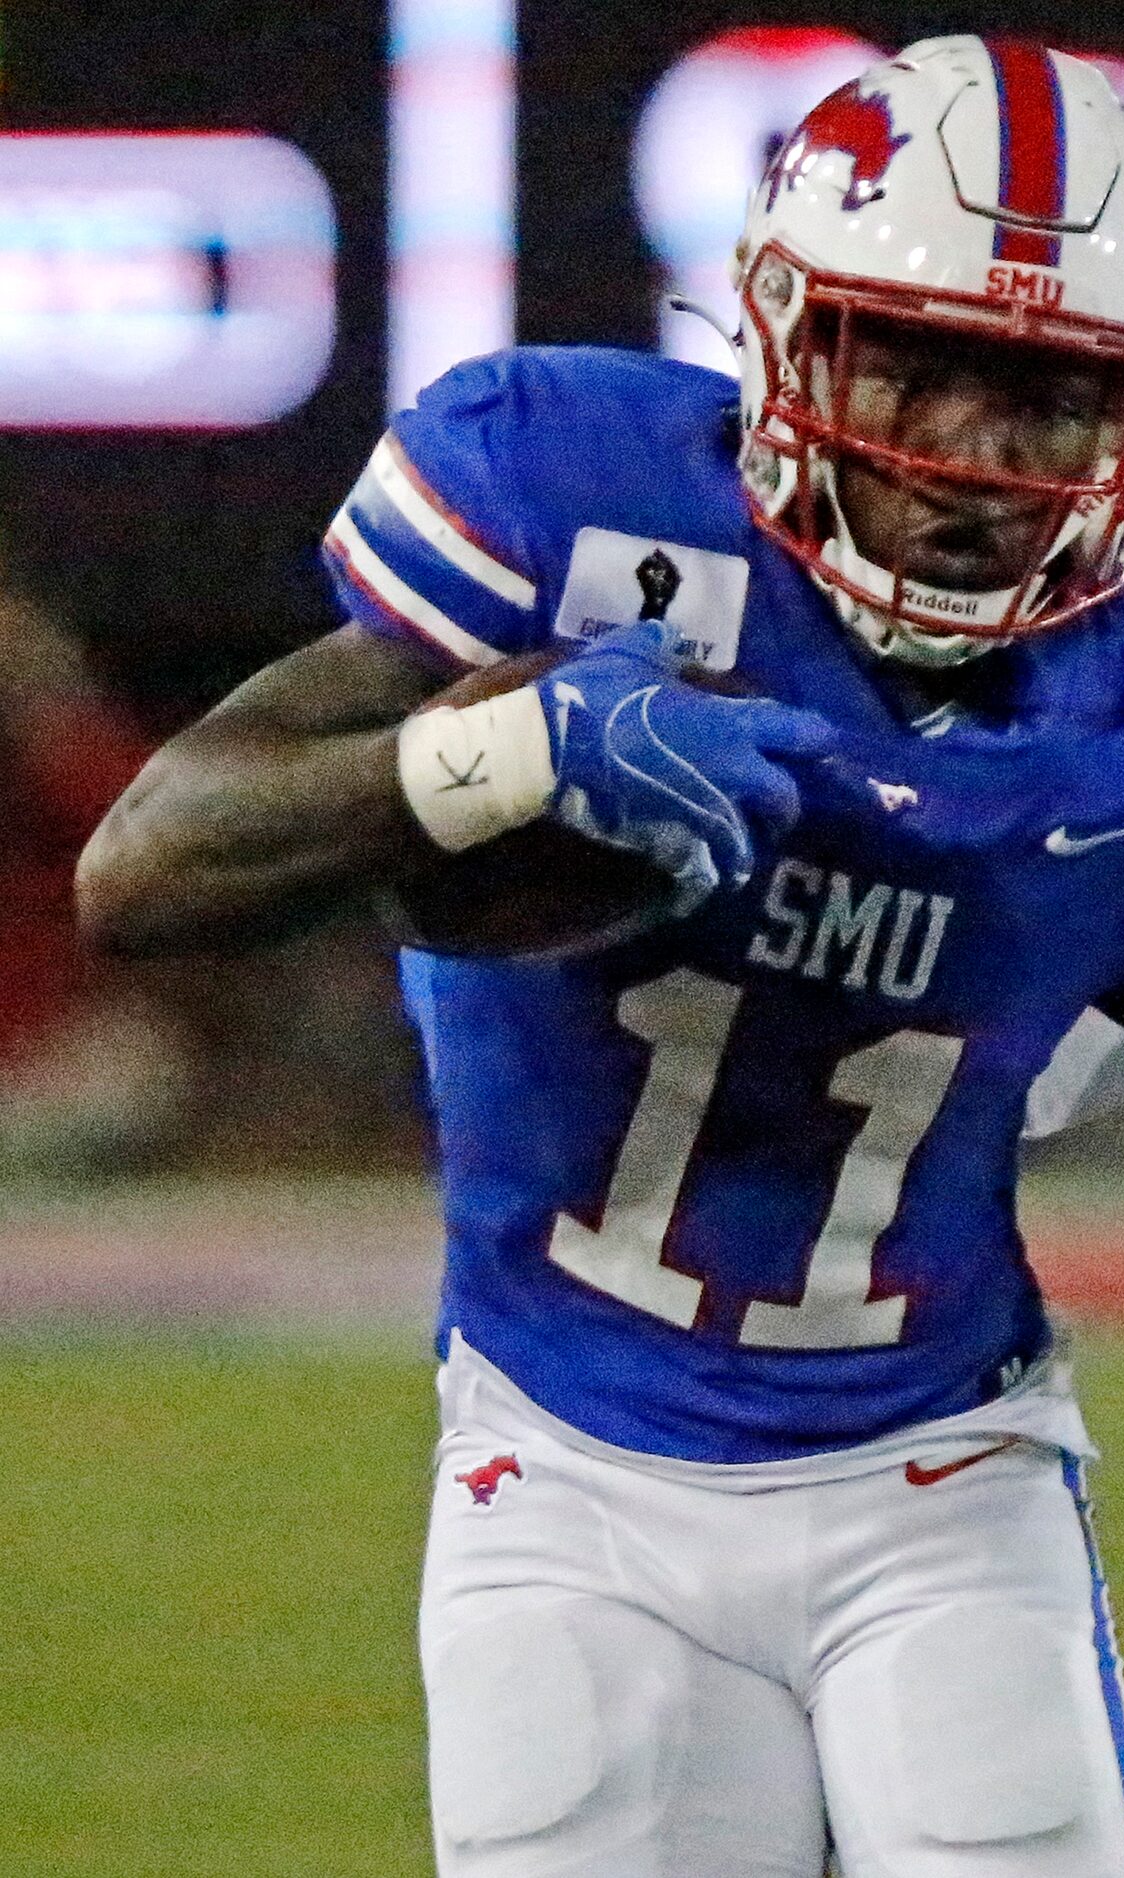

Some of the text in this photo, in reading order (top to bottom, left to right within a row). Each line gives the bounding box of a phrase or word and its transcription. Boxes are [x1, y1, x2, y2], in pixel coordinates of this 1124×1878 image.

[985, 267, 1064, 310] SMU
[747, 858, 955, 1000] SMU
[548, 966, 966, 1349] 11
